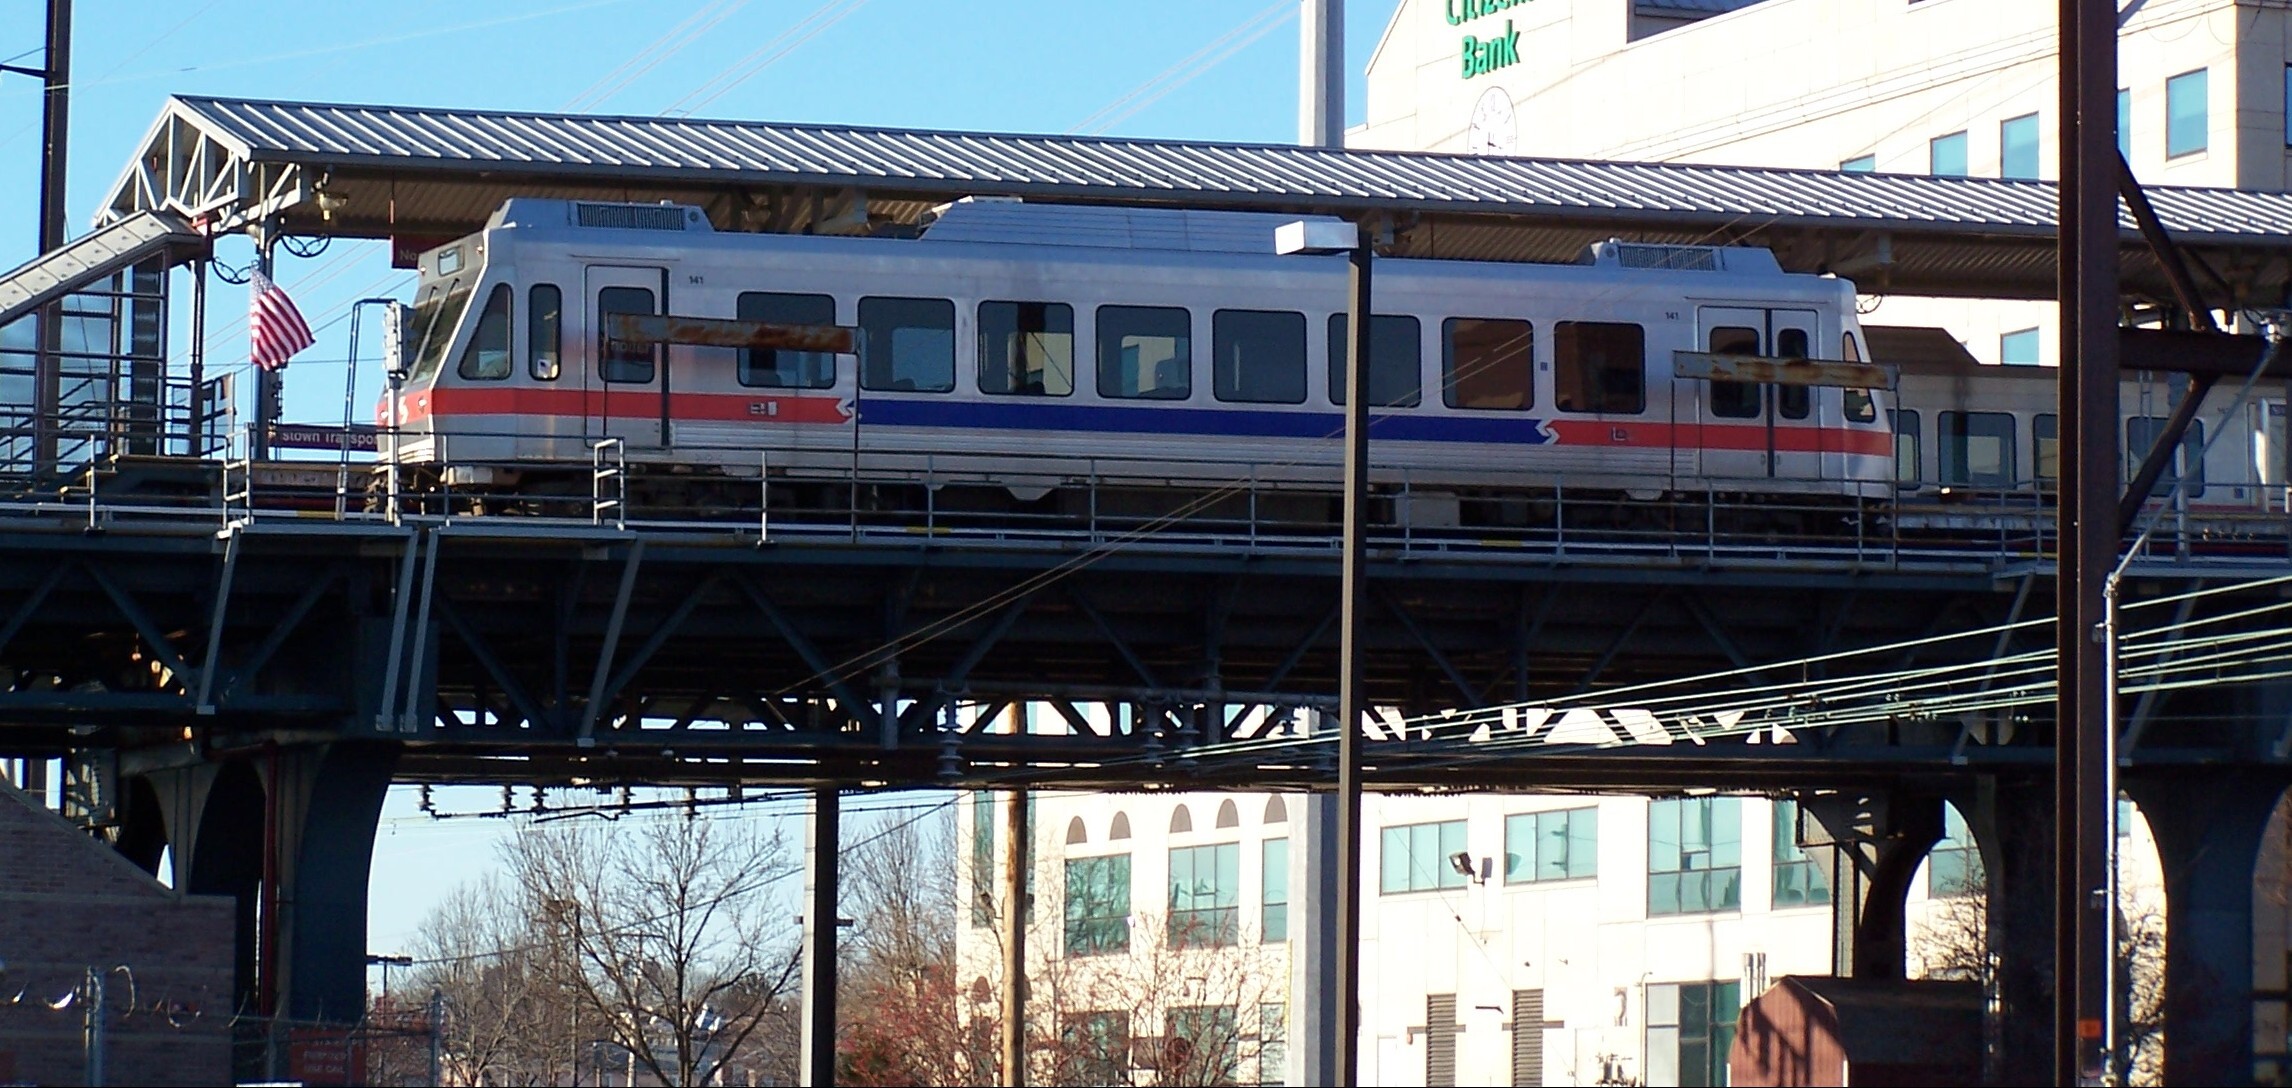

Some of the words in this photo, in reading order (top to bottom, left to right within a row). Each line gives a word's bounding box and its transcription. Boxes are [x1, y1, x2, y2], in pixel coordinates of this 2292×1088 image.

[1446, 0, 1534, 26] Citiz
[1462, 19, 1521, 79] Bank
[689, 275, 704, 285] 141
[1664, 311, 1679, 320] 141
[325, 433, 377, 447] Traspo
